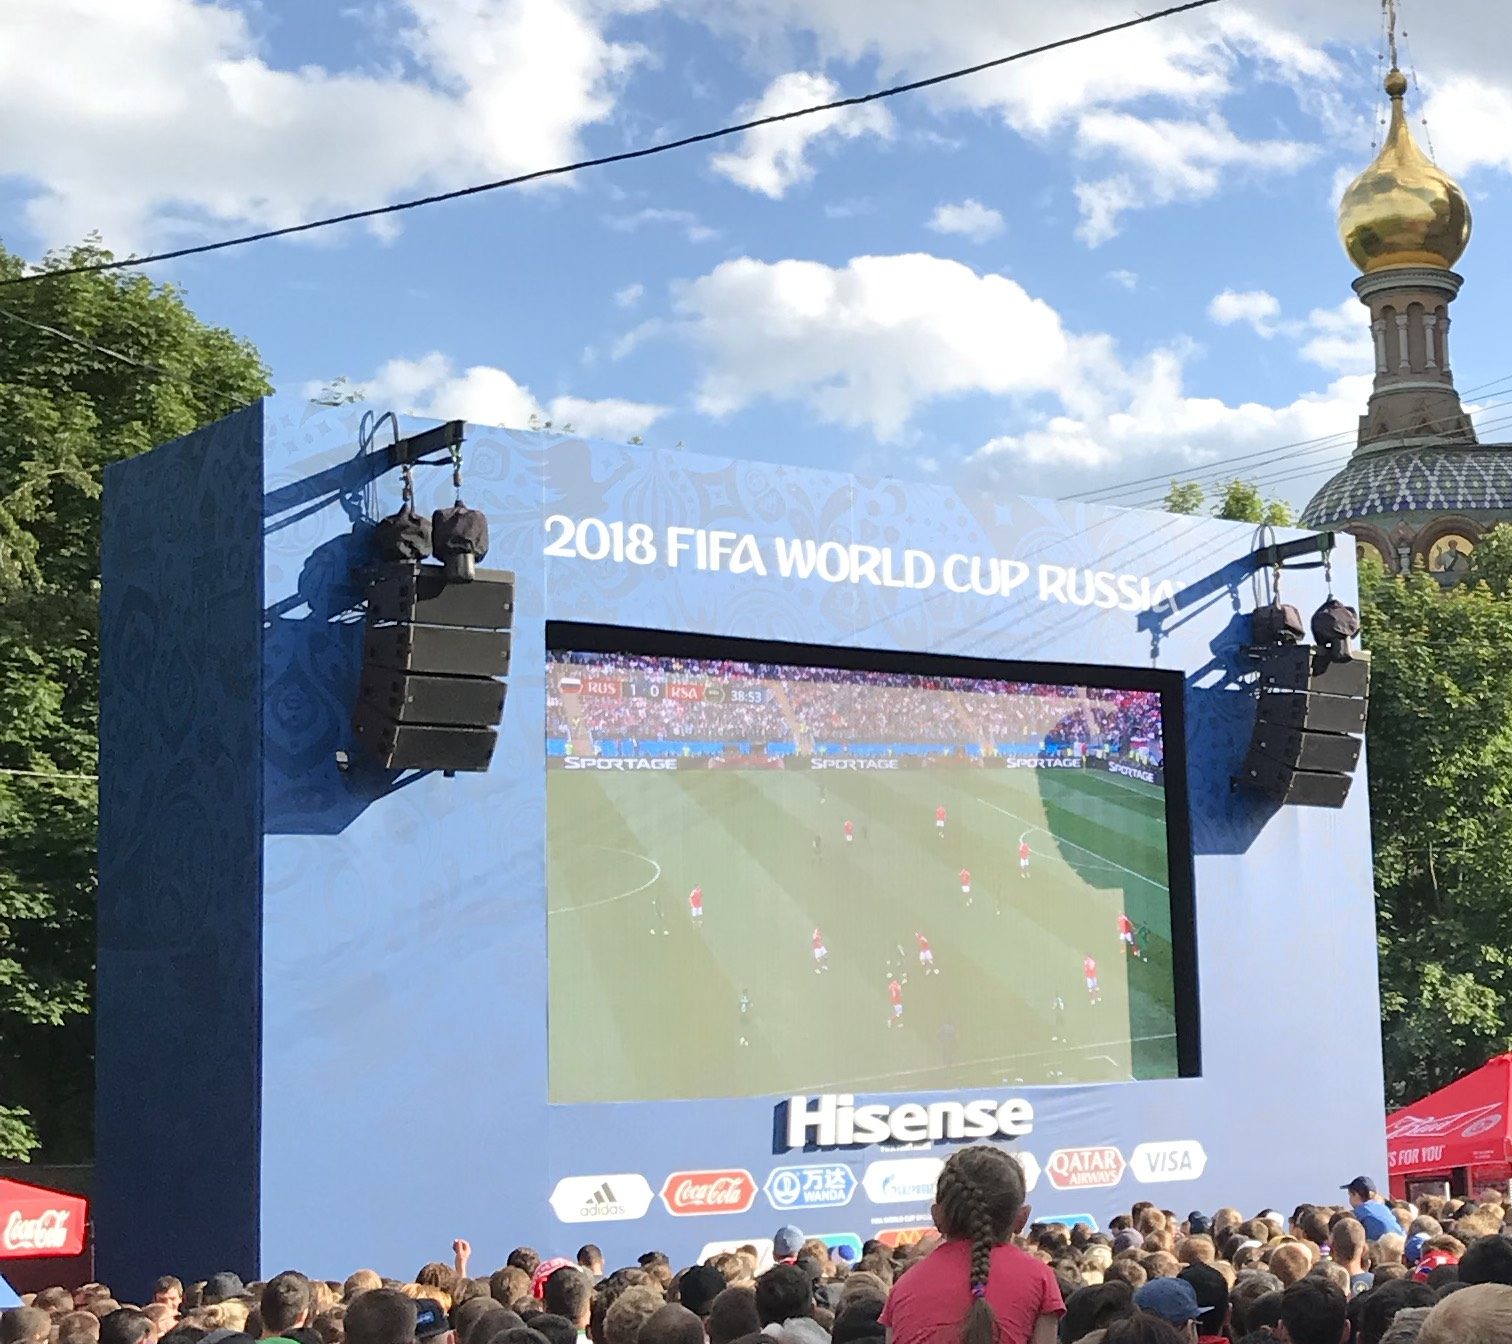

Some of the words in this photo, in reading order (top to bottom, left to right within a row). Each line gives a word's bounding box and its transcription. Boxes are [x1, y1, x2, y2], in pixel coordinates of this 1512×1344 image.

[543, 515, 657, 565] 2018
[667, 526, 767, 576] FIFA
[775, 536, 936, 590] WORLD
[943, 553, 1030, 596] CUP
[1038, 563, 1181, 616] RUSSIA
[588, 682, 617, 694] RUS
[629, 683, 637, 696] 1
[650, 684, 660, 697] 0
[671, 687, 698, 700] RSA
[730, 689, 762, 703] 38:53
[564, 756, 678, 771] SPORTAGE
[810, 757, 898, 771] SPORTAGE
[1006, 757, 1081, 769] SPORTAGE
[1108, 761, 1154, 783] SPORTAGE
[787, 1093, 1034, 1148] Hisense
[1053, 1150, 1117, 1177] QATAR
[1145, 1150, 1192, 1173] VISA
[1398, 1148, 1420, 1166] FOR
[803, 1168, 847, 1189] 万达
[1069, 1169, 1118, 1185] AIRWAYS
[803, 1188, 846, 1203] WANDA
[580, 1202, 626, 1217] adidas
